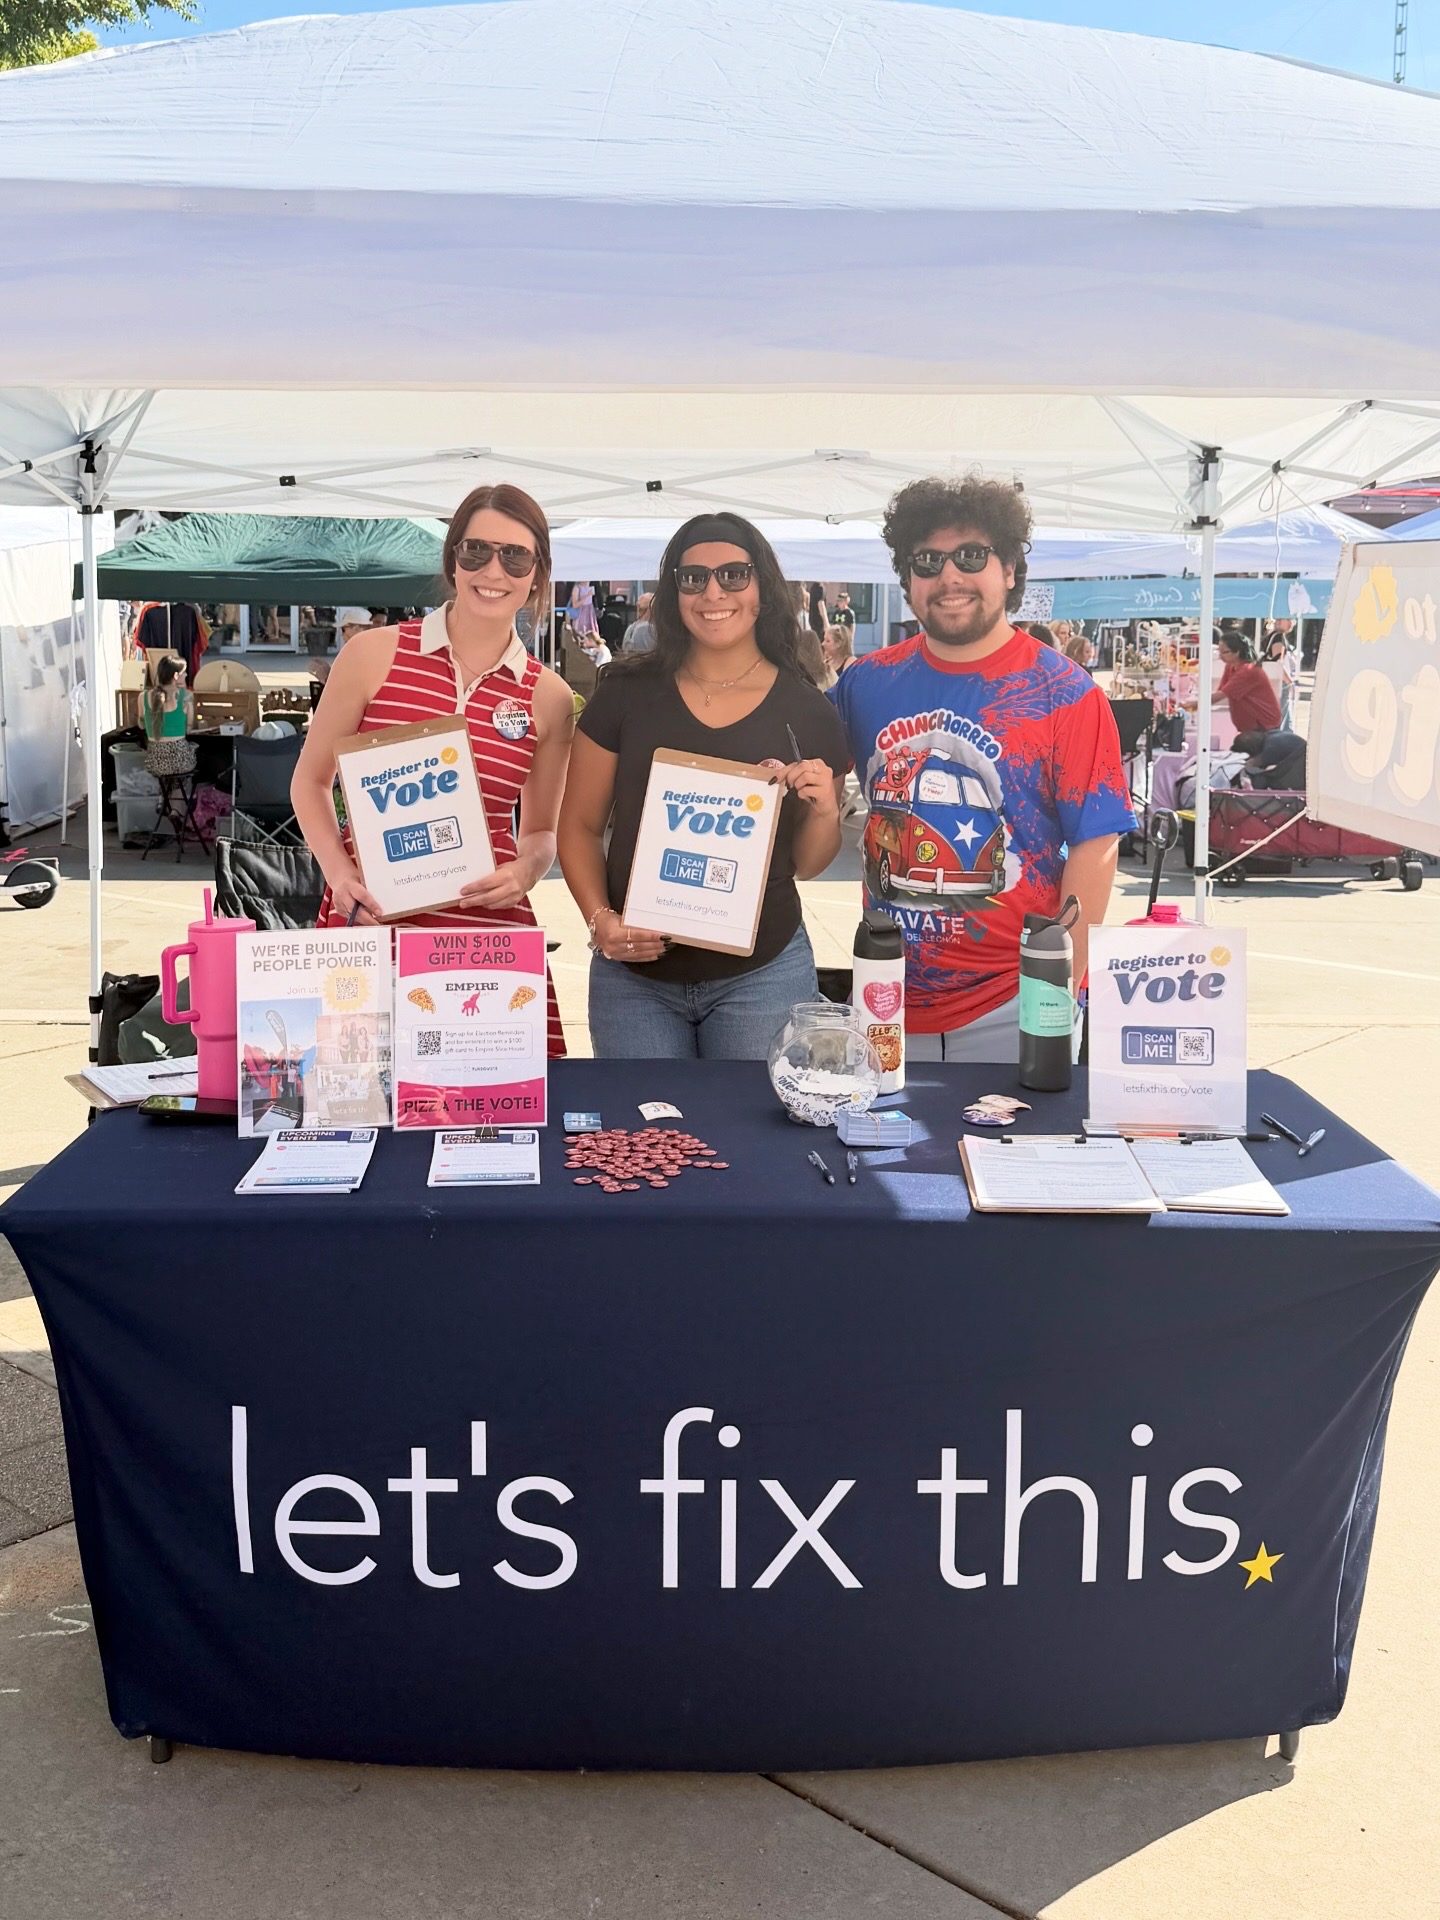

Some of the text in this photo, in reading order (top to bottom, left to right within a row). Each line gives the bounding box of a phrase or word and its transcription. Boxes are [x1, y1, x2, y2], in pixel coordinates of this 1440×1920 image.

[495, 711, 526, 720] Register
[877, 710, 1001, 761] CHINCHORREO
[361, 756, 439, 788] Register to
[366, 769, 459, 814] Vote
[662, 790, 743, 807] Register to
[666, 803, 756, 838] Vote
[402, 829, 427, 841] SCAN
[404, 839, 429, 854] ME!
[680, 857, 705, 869] SCAN
[393, 864, 467, 886] letsfixthis.org/vote
[678, 868, 703, 881] ME!
[655, 896, 729, 918] letsfixthis.org/vote
[251, 940, 377, 957] WE'RE BUILDING
[433, 934, 511, 949] WIN $100
[253, 956, 376, 972] PEOPLE POWER.
[428, 951, 516, 965] GIFT CARD
[1107, 952, 1206, 972] Register to
[287, 985, 306, 995] Join
[445, 982, 499, 992] EMPIRE
[1113, 969, 1226, 1005] Vote
[1144, 1034, 1173, 1043] SCAN
[1144, 1045, 1173, 1058] ME!
[1123, 1084, 1213, 1096] letsfixthis.org/vote
[404, 1096, 538, 1113] PIZZA THE VOTE!
[232, 1406, 577, 1589] let's
[641, 1407, 863, 1588] fix
